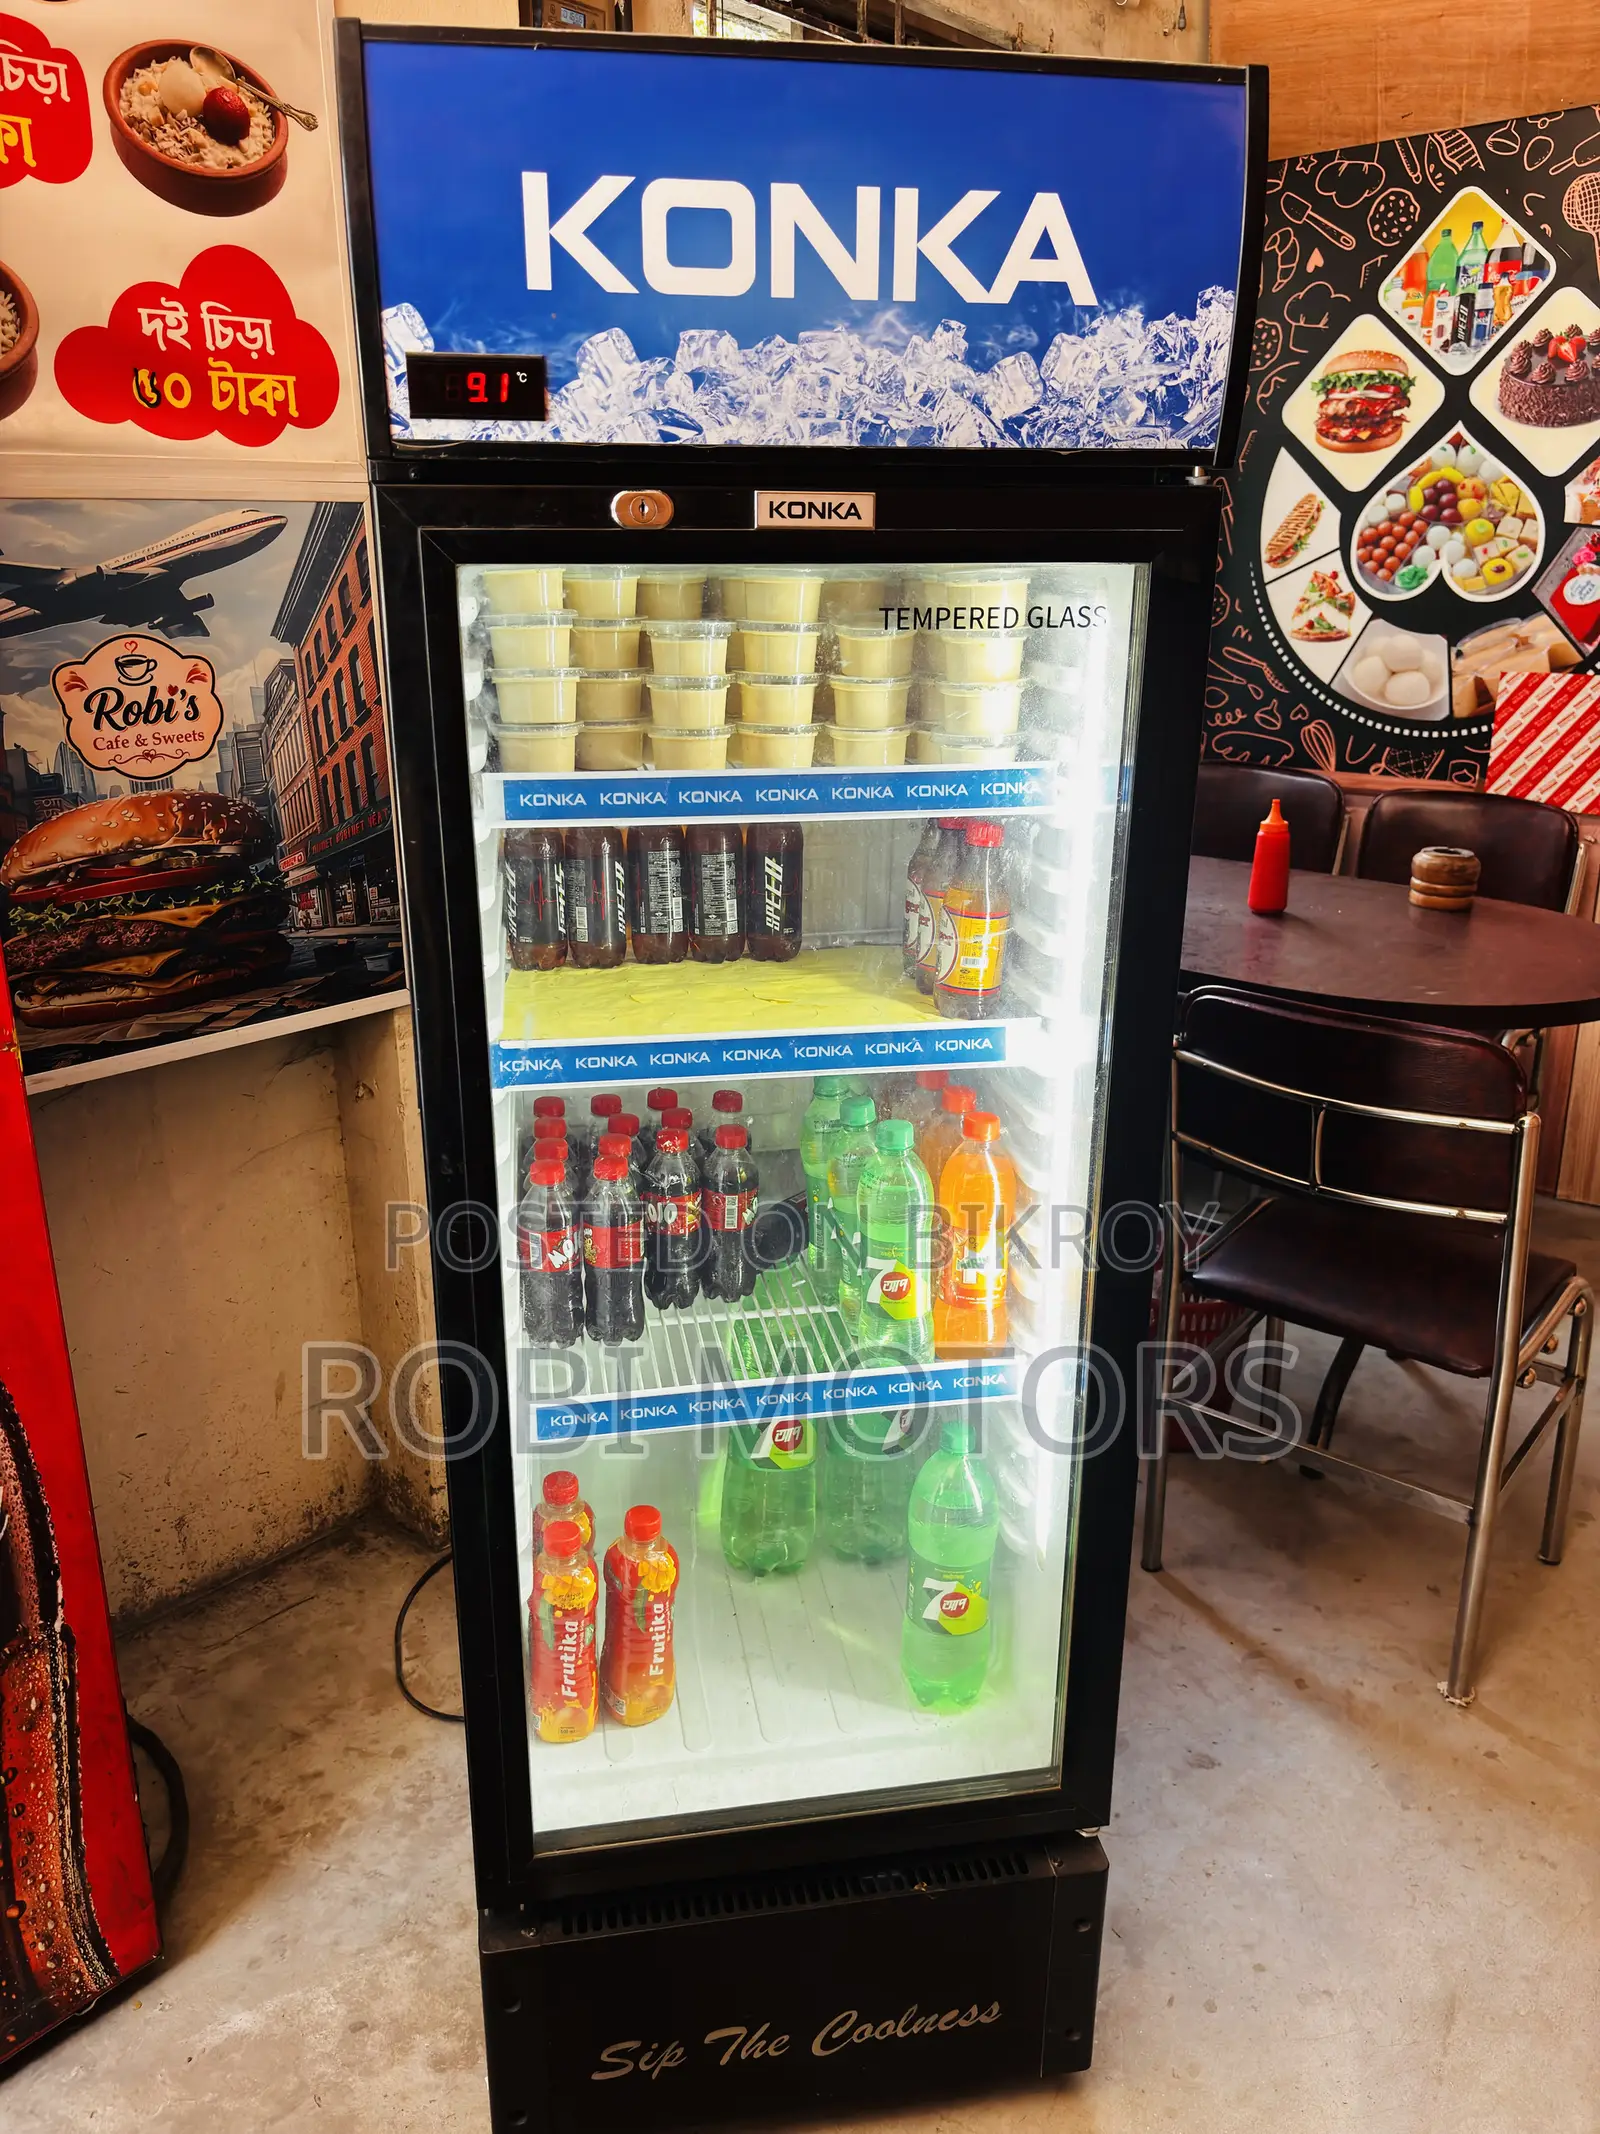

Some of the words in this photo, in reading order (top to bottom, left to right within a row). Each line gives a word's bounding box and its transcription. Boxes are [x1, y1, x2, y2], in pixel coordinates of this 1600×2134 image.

[521, 171, 1099, 306] KONKA
[137, 297, 192, 352] দই
[200, 301, 275, 360] চিড়া
[207, 356, 299, 418] টাকা
[768, 500, 863, 521] KONKA
[878, 606, 1019, 631] TEMPERED
[1027, 605, 1107, 629] GLASS
[83, 684, 201, 732] Robi's
[93, 735, 130, 751] Cafe
[134, 733, 149, 747] &
[152, 730, 205, 746] Sweets
[519, 793, 587, 807] KONKA
[600, 791, 666, 805] KONKA
[678, 790, 743, 804] KONKA
[755, 788, 819, 802] KONKA
[831, 786, 894, 800] KONKA
[906, 783, 969, 798] KONKA
[980, 781, 1042, 796] KONKA
[764, 856, 784, 932] SPEED
[500, 1058, 563, 1073] KONKA
[575, 1055, 637, 1069] KONKA
[650, 1051, 711, 1066] KONKA
[723, 1048, 783, 1062] KONKA
[794, 1044, 853, 1058] KONKA
[865, 1040, 924, 1055] KONKA
[935, 1037, 993, 1052] KONKA
[645, 1202, 678, 1225] OJO
[551, 1412, 609, 1427] KONKA
[620, 1404, 678, 1420] KONKA
[689, 1398, 746, 1413] KONKA
[756, 1391, 812, 1407] KONKA
[823, 1385, 878, 1400] KONKA
[888, 1379, 943, 1394] KONKA
[953, 1373, 1008, 1388] KONKA
[561, 1619, 579, 1699] Frutika
[649, 1602, 666, 1677] Frutika
[590, 2040, 688, 2081] Sip
[703, 2022, 790, 2067] The
[811, 2001, 1003, 2057] Coolness
